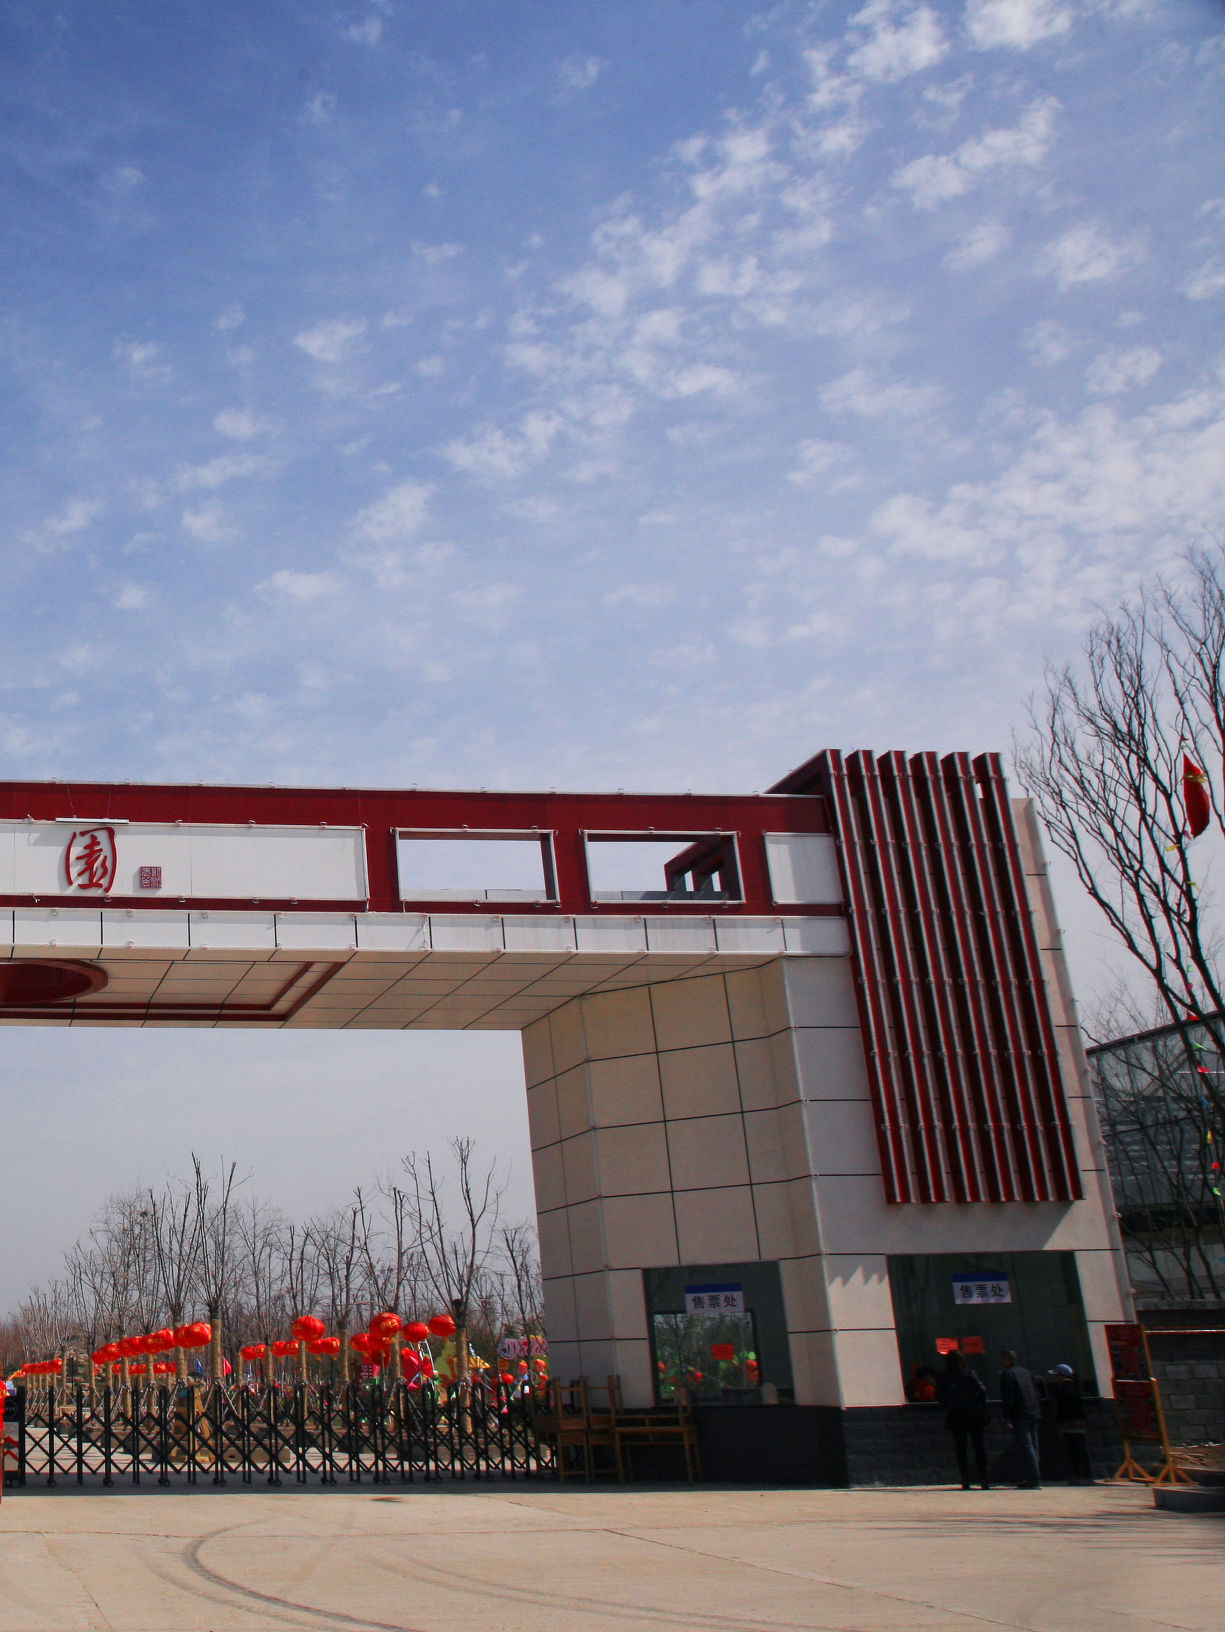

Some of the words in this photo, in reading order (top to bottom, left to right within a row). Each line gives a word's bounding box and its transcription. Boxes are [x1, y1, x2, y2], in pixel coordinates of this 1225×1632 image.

[960, 1283, 1005, 1298] 售票处
[692, 1294, 737, 1309] 售票处
